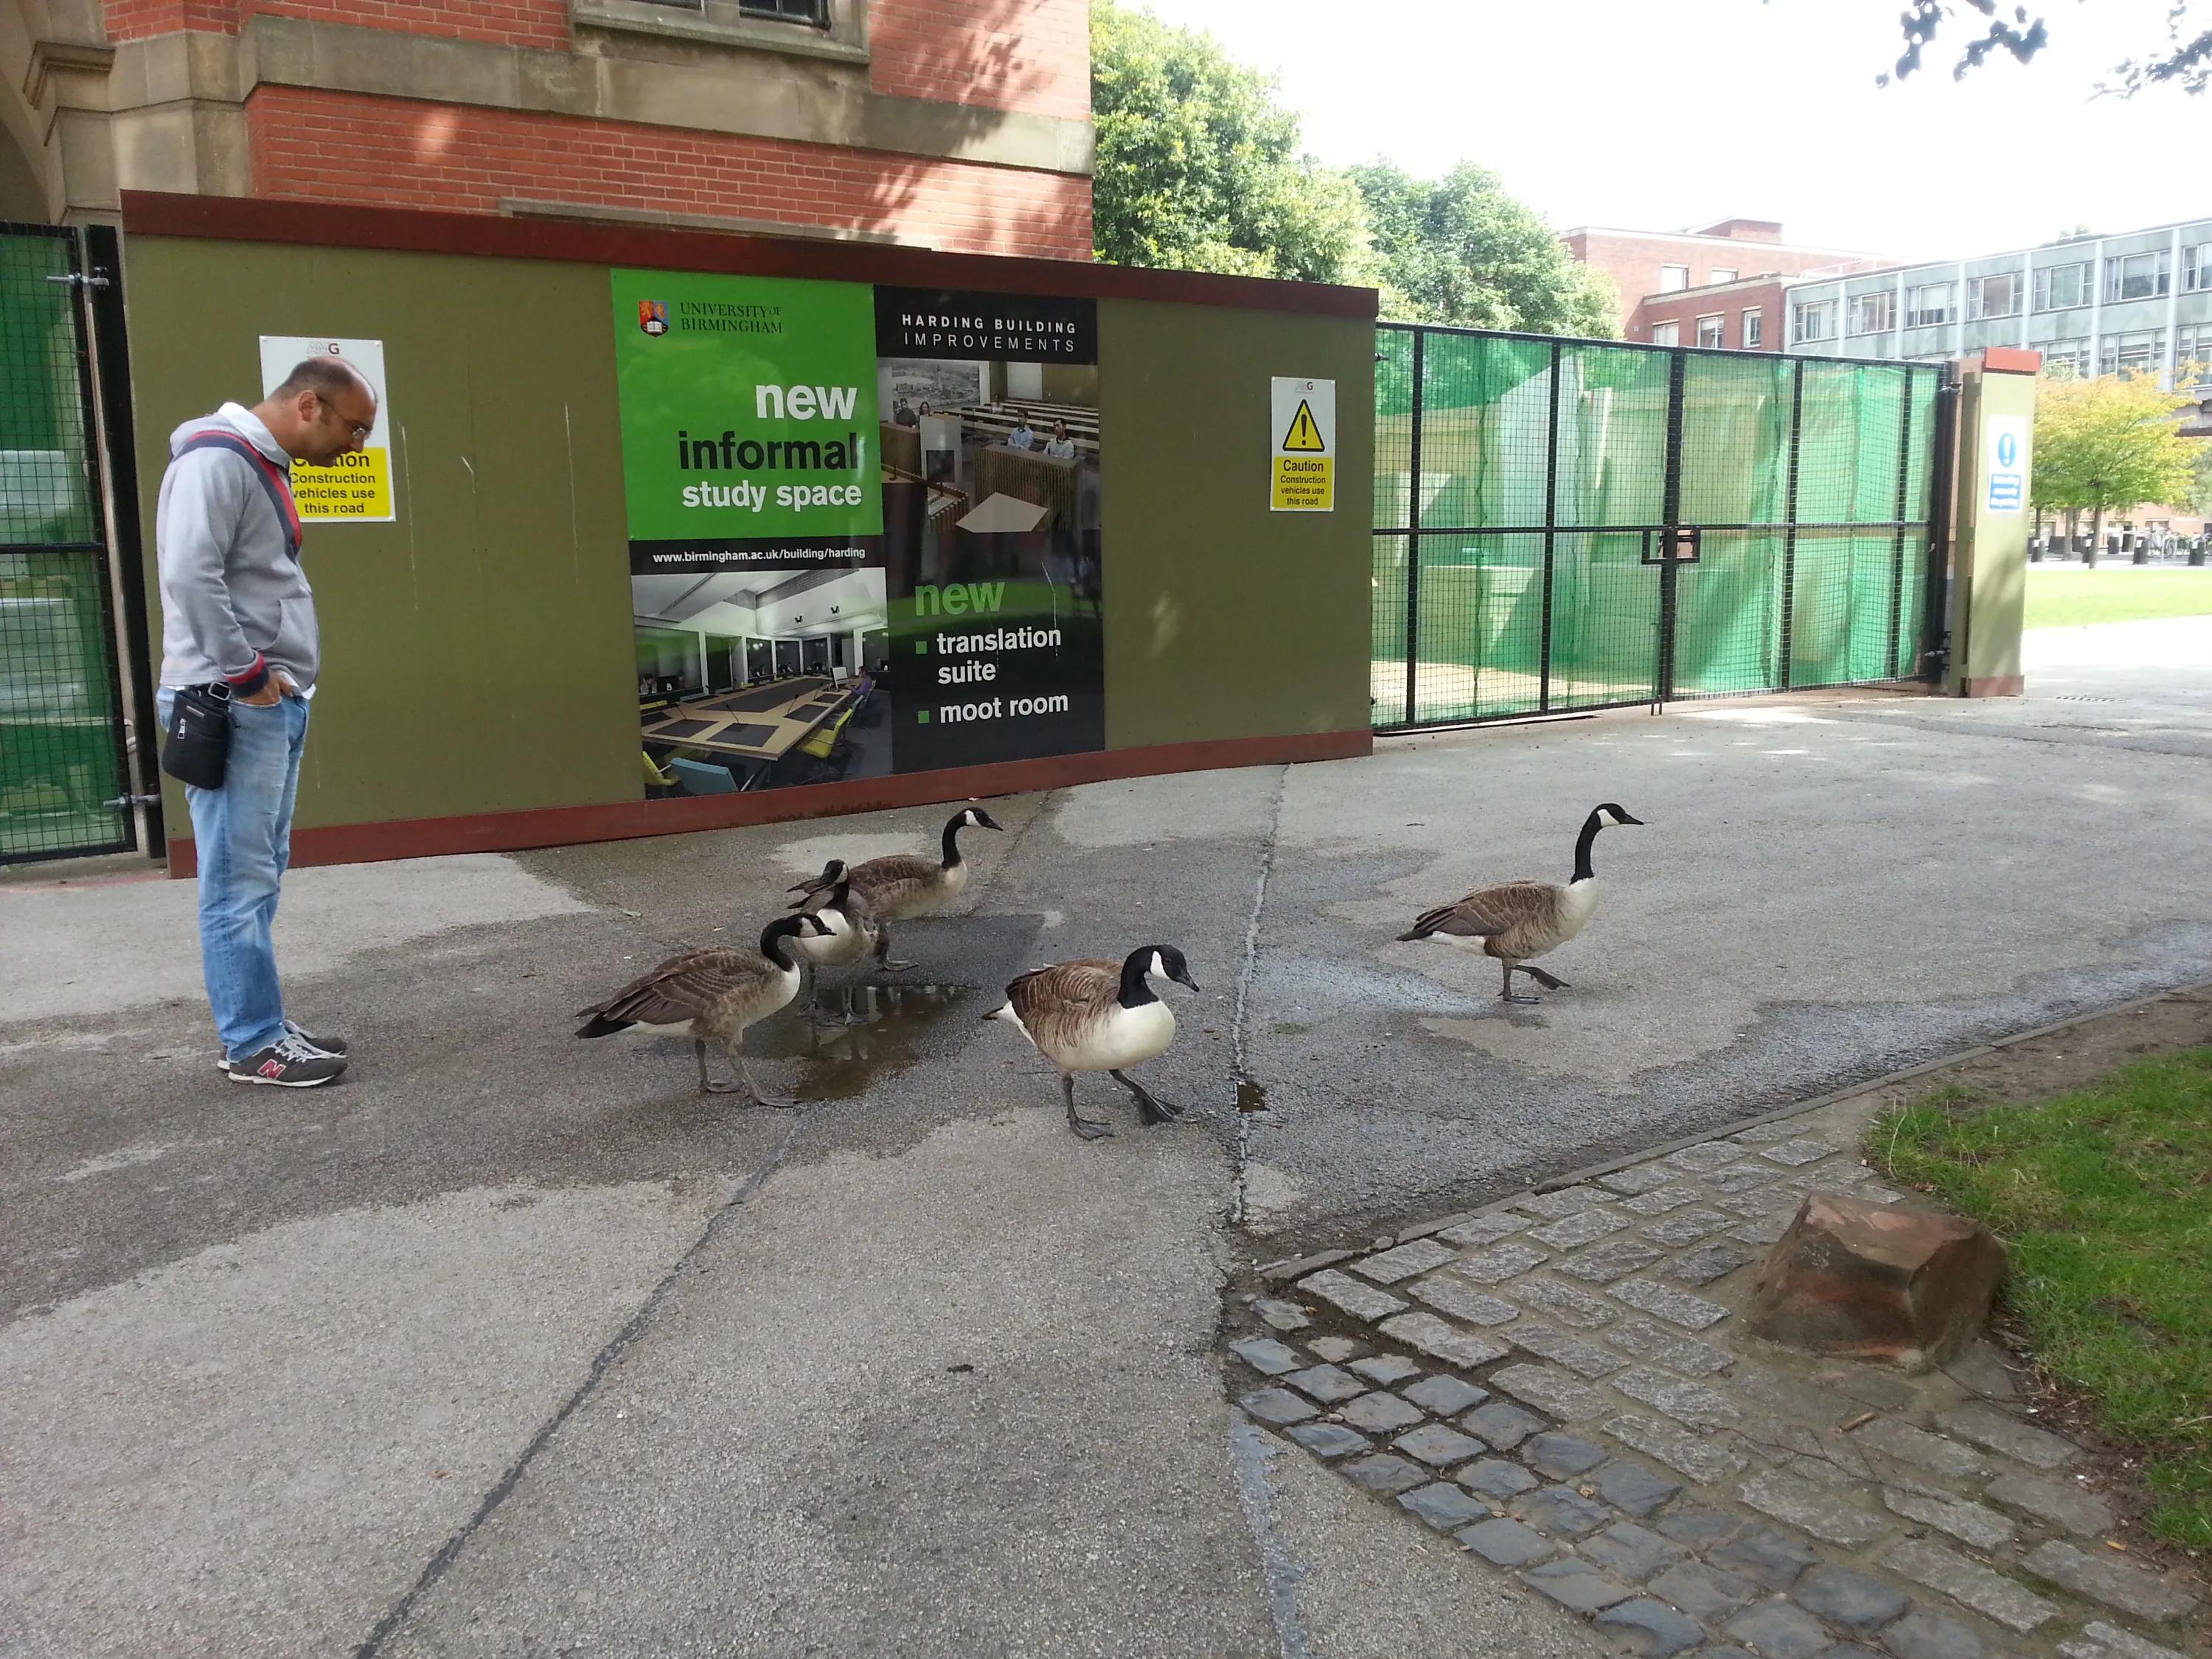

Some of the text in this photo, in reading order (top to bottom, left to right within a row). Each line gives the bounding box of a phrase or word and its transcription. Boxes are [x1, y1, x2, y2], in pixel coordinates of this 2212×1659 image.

[680, 302, 782, 318] UNIVERSITY OF
[681, 319, 782, 333] BIRMINGHAM
[902, 314, 1076, 333] HARDING BUILDING
[904, 333, 1074, 352] IMPROVEMENTS
[756, 385, 858, 420] new
[678, 431, 858, 470] informal
[1283, 459, 1324, 472] Caution
[290, 473, 376, 484] Construction
[1280, 475, 1326, 484] Construction
[352, 490, 375, 498] use
[682, 480, 863, 512] study space
[1281, 487, 1310, 495] vehicles
[305, 503, 365, 513] this road
[1287, 497, 1318, 505] this road
[653, 547, 866, 563] www.birmingham.ac.uk/building/harding
[915, 581, 1005, 616] new
[936, 626, 1062, 655] translation
[937, 659, 996, 685] suite
[940, 694, 1069, 723] moot room
